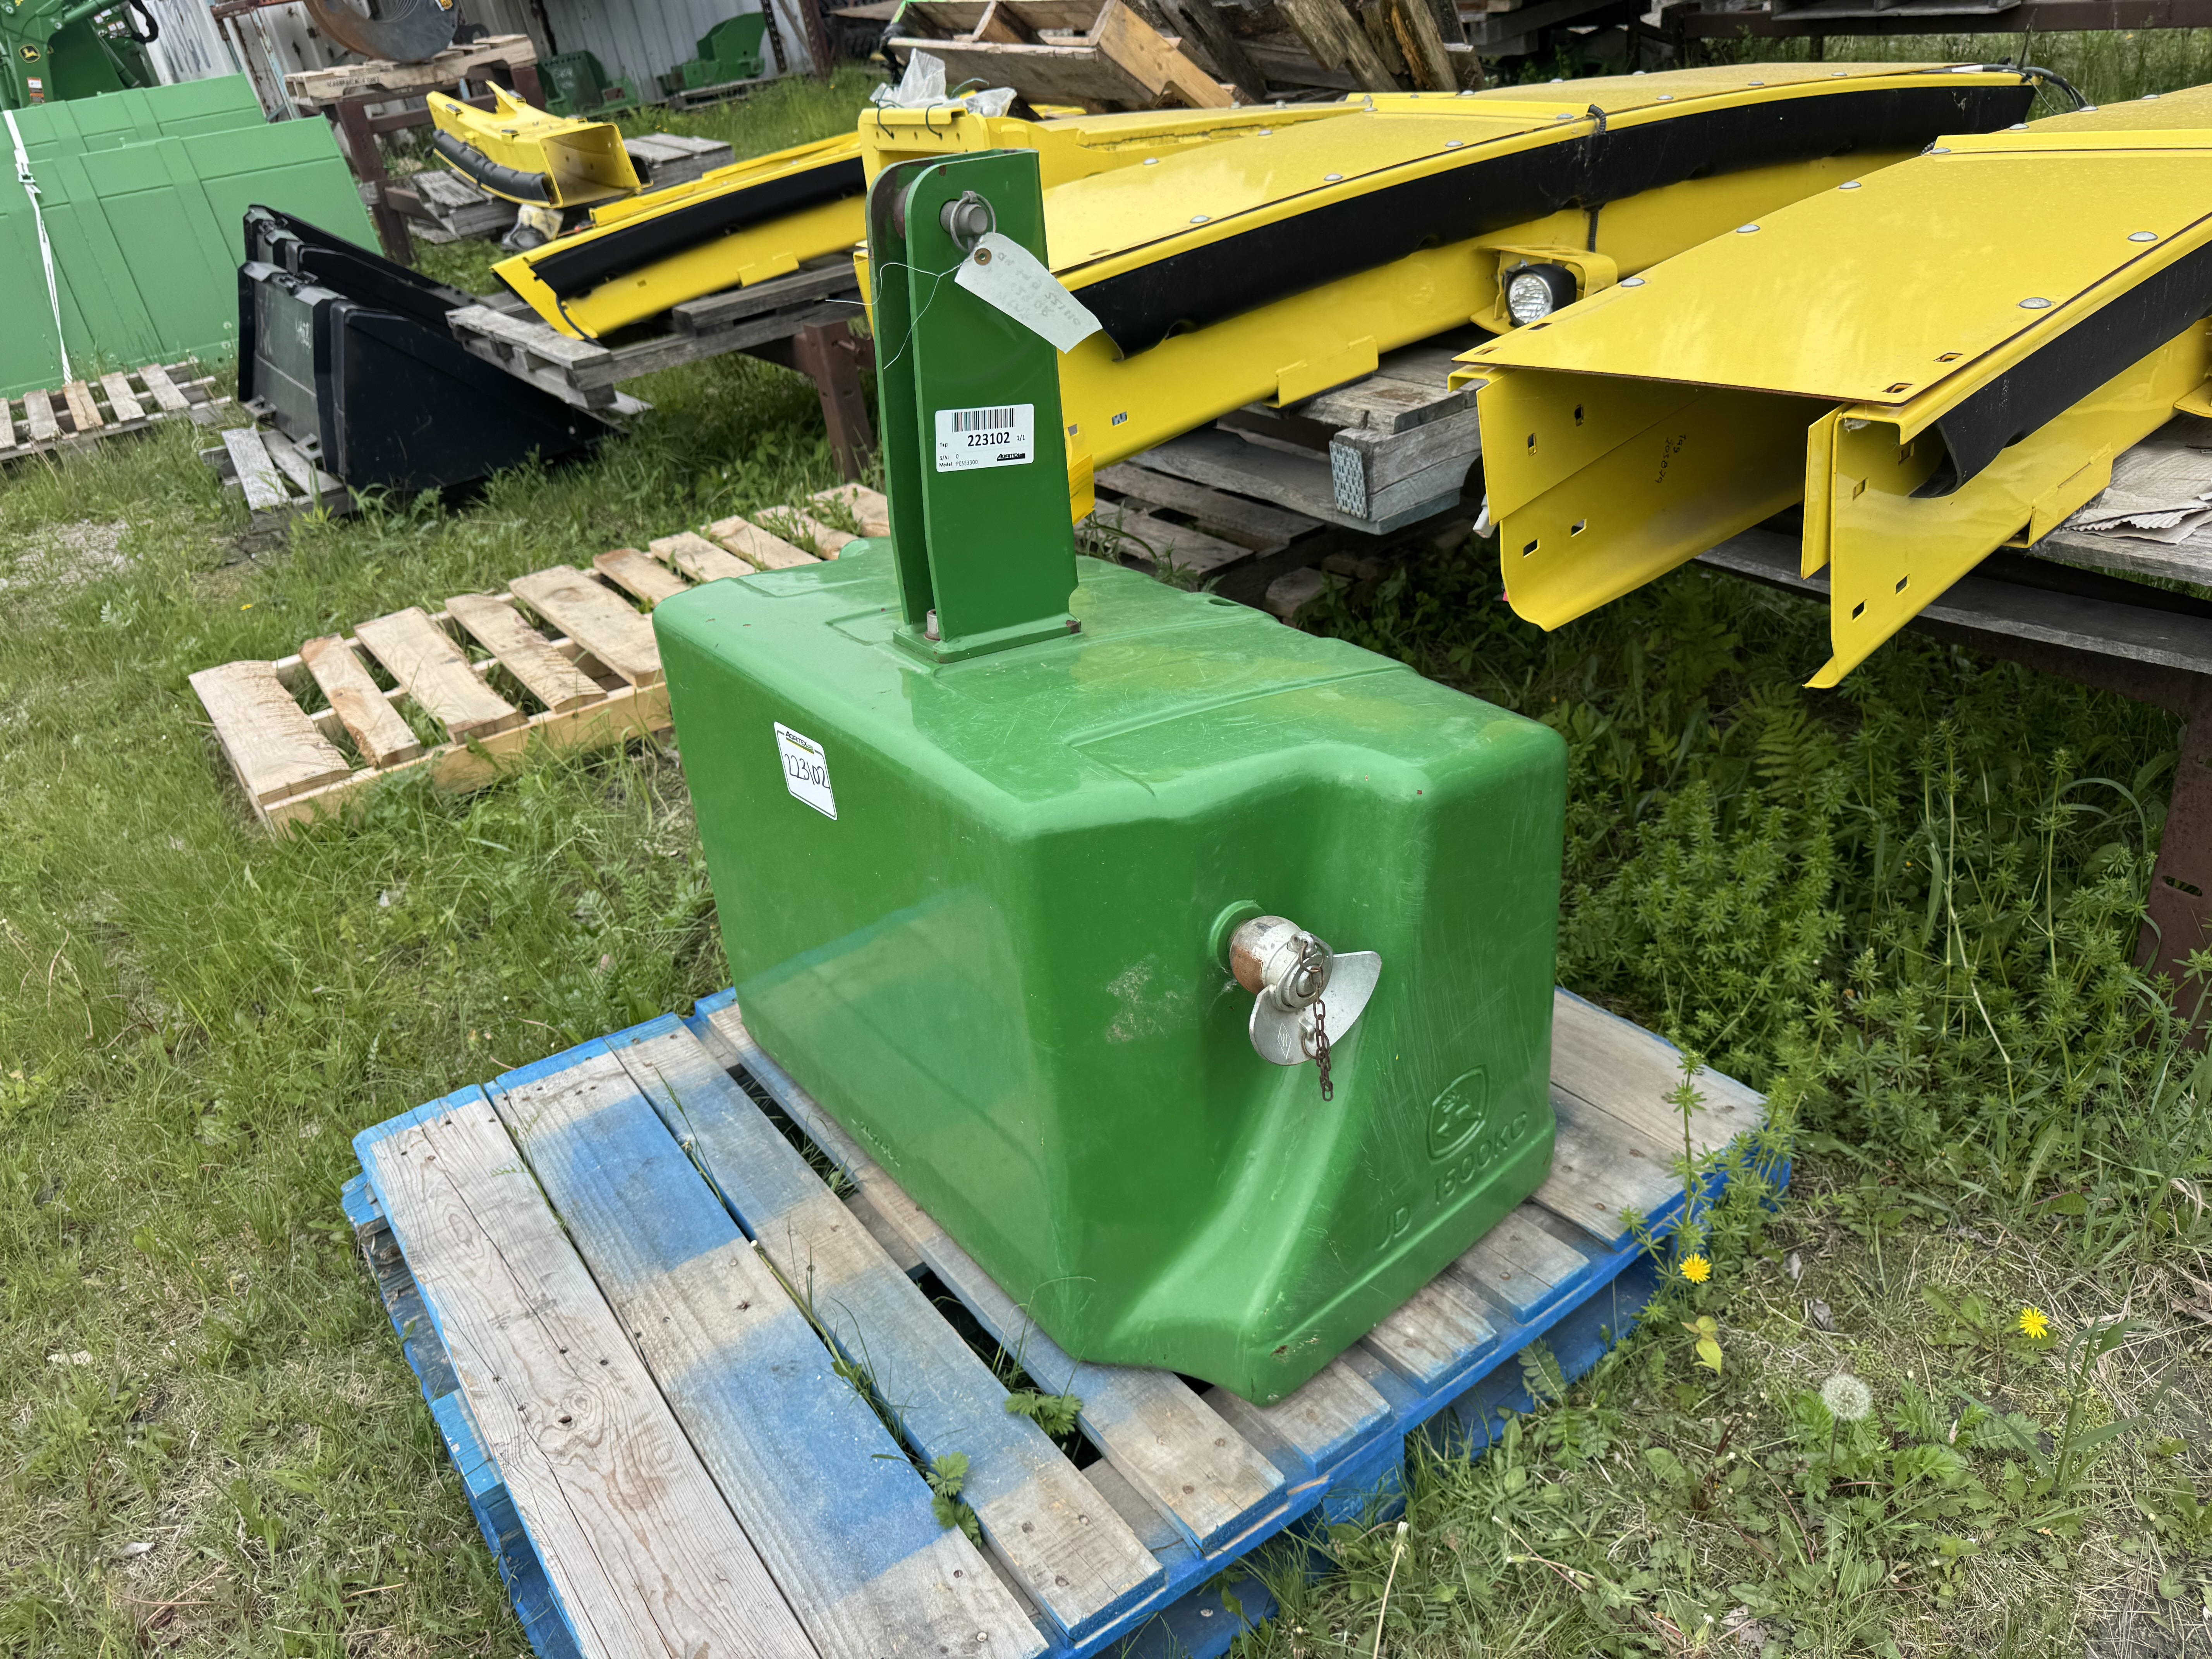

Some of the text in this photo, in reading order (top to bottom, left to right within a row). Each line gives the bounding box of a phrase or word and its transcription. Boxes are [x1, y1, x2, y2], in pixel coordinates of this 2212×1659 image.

[968, 432, 1010, 447] 223102
[785, 731, 808, 747] AGRITEX
[785, 754, 830, 790] 223102
[1375, 1110, 1527, 1252] JD 1500KG
